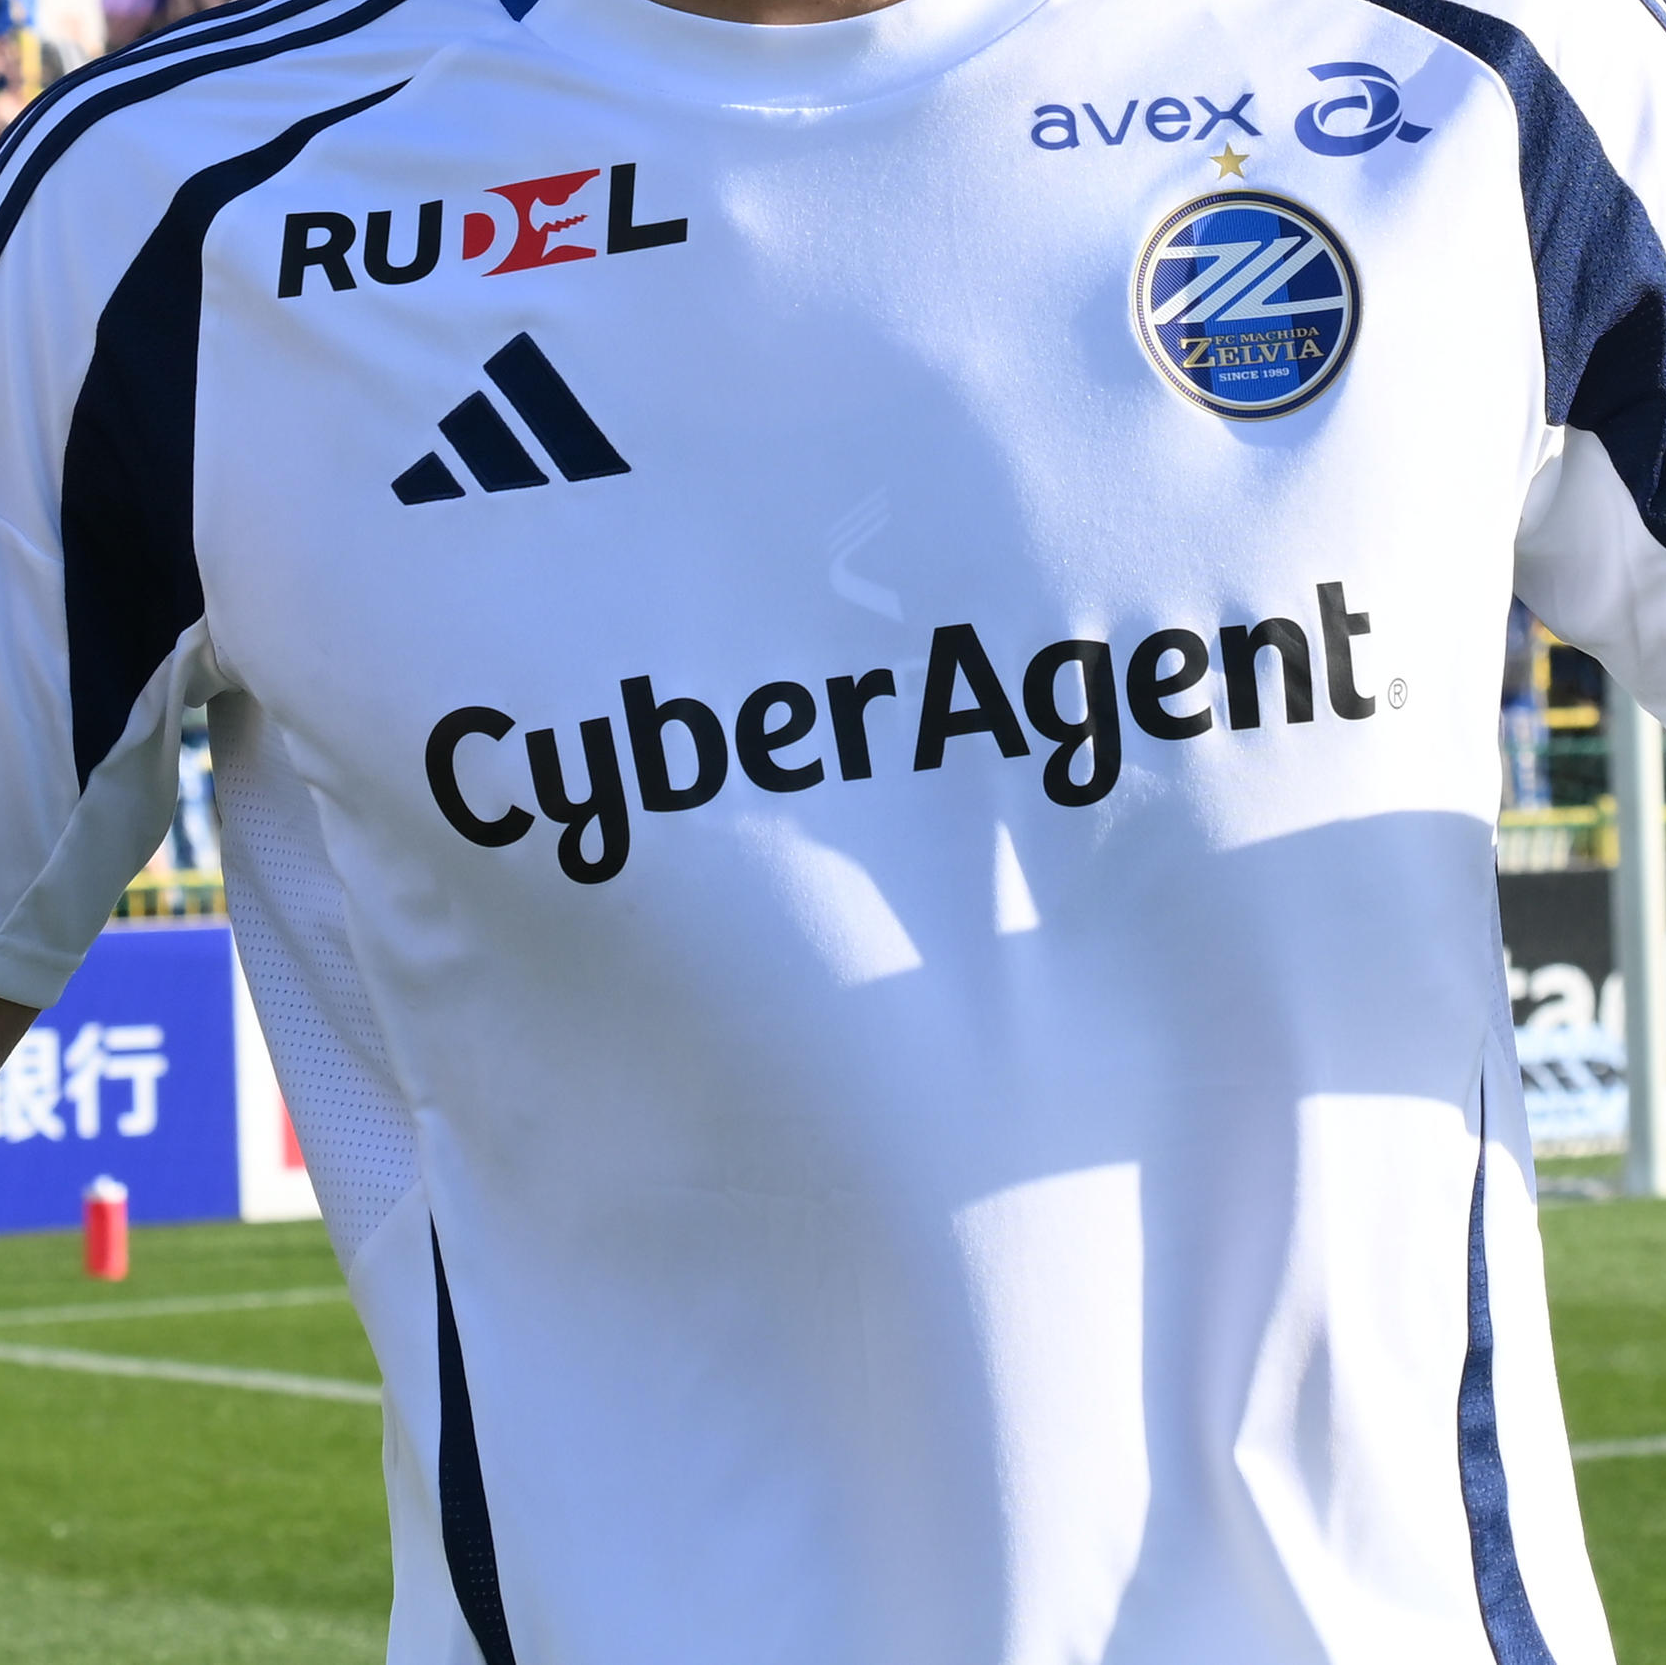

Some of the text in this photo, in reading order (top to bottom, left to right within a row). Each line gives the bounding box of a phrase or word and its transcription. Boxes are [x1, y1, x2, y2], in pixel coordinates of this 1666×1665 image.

[1031, 93, 1263, 151] avex
[278, 162, 688, 298] RUDEL
[1180, 337, 1325, 369] ZELVIA
[1214, 326, 1320, 346] FC MACHIDA
[1218, 371, 1259, 383] SINCE
[424, 581, 1376, 885] CyberAgent
